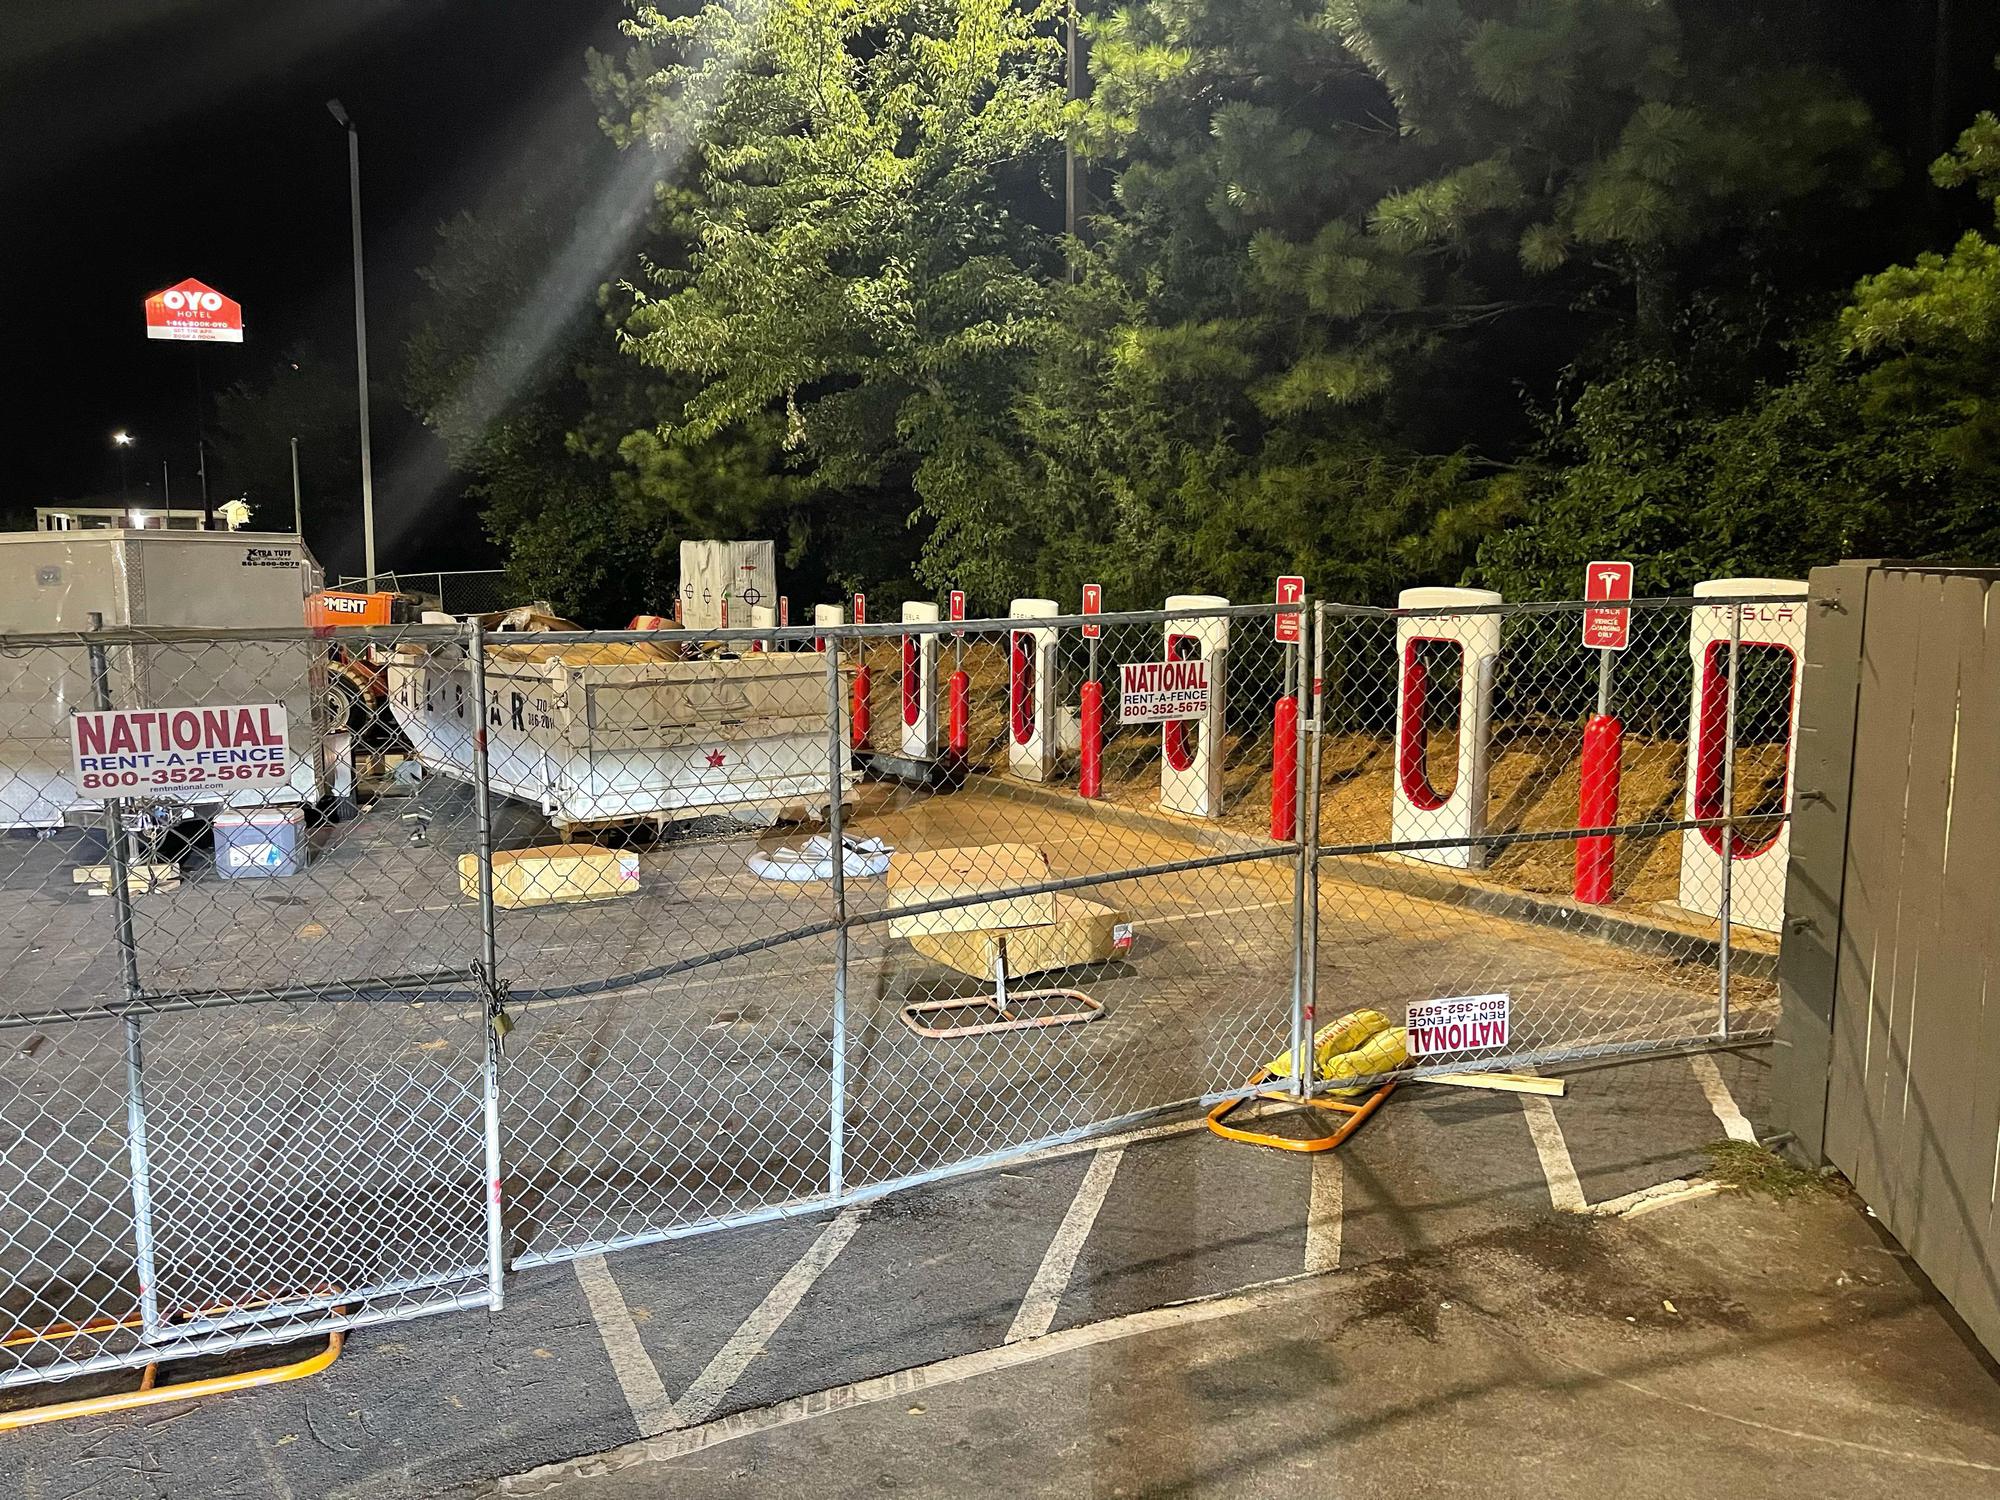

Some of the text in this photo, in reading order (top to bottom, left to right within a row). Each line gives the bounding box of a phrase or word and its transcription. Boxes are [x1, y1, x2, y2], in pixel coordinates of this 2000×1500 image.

[163, 290, 222, 311] OYO
[177, 311, 212, 319] HOTEL
[1591, 624, 1620, 633] CHARGING
[1595, 618, 1618, 626] VEHICLE
[1125, 662, 1208, 694] NATIONAL
[1124, 690, 1207, 704] RENT-A-FENCE
[1124, 701, 1207, 717] 800-352-5675
[77, 707, 283, 755] NATIONAL
[81, 748, 285, 771] RENT-A-FENCE
[83, 763, 285, 788] 800-352-5675
[150, 782, 223, 792] rentnational.com
[1409, 1000, 1505, 1017] 800-352-5675
[1409, 1010, 1505, 1027] RENT-A-FENCE
[1409, 1020, 1505, 1053] NATIONAL
